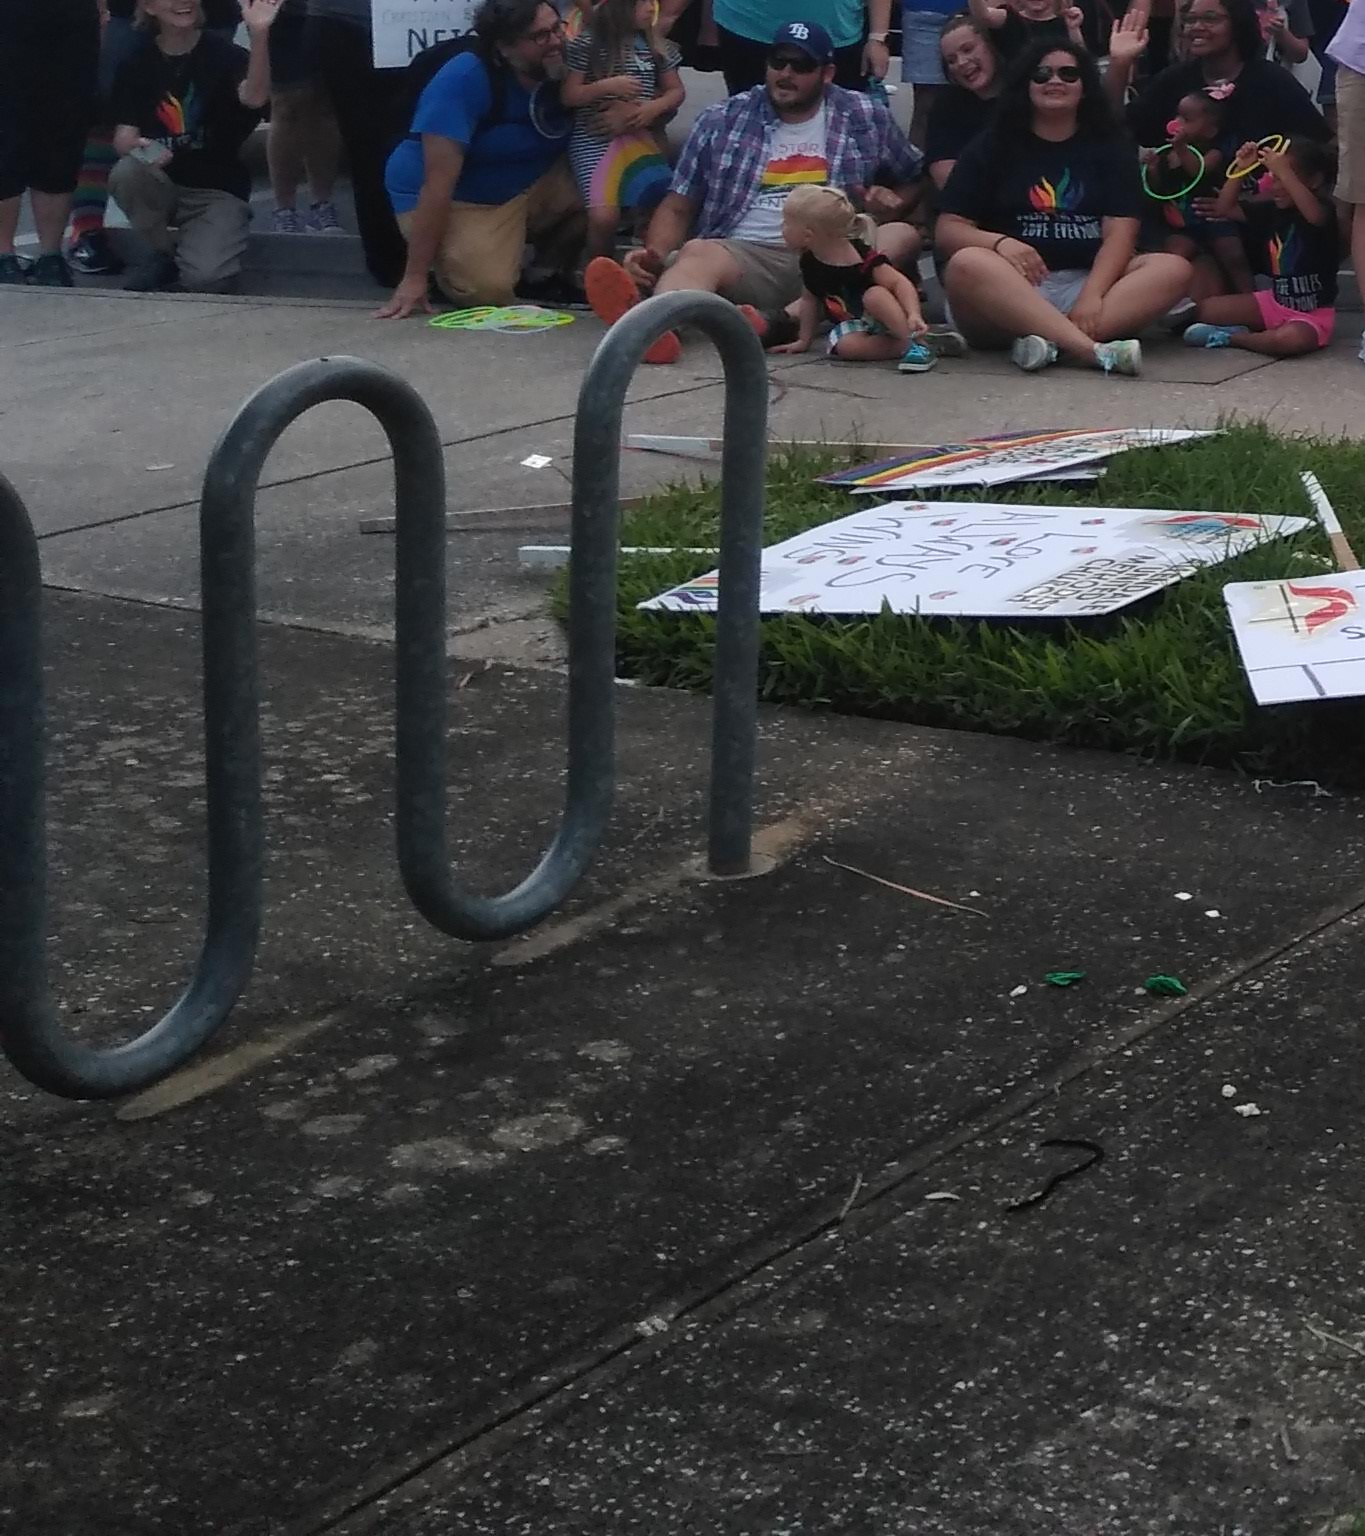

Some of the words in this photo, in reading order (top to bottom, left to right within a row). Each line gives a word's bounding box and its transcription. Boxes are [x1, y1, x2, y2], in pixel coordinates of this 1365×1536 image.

[788, 22, 810, 40] TB
[1004, 558, 1116, 604] CHURCH
[1020, 554, 1157, 611] METHODIST
[1075, 566, 1165, 602] UNITED
